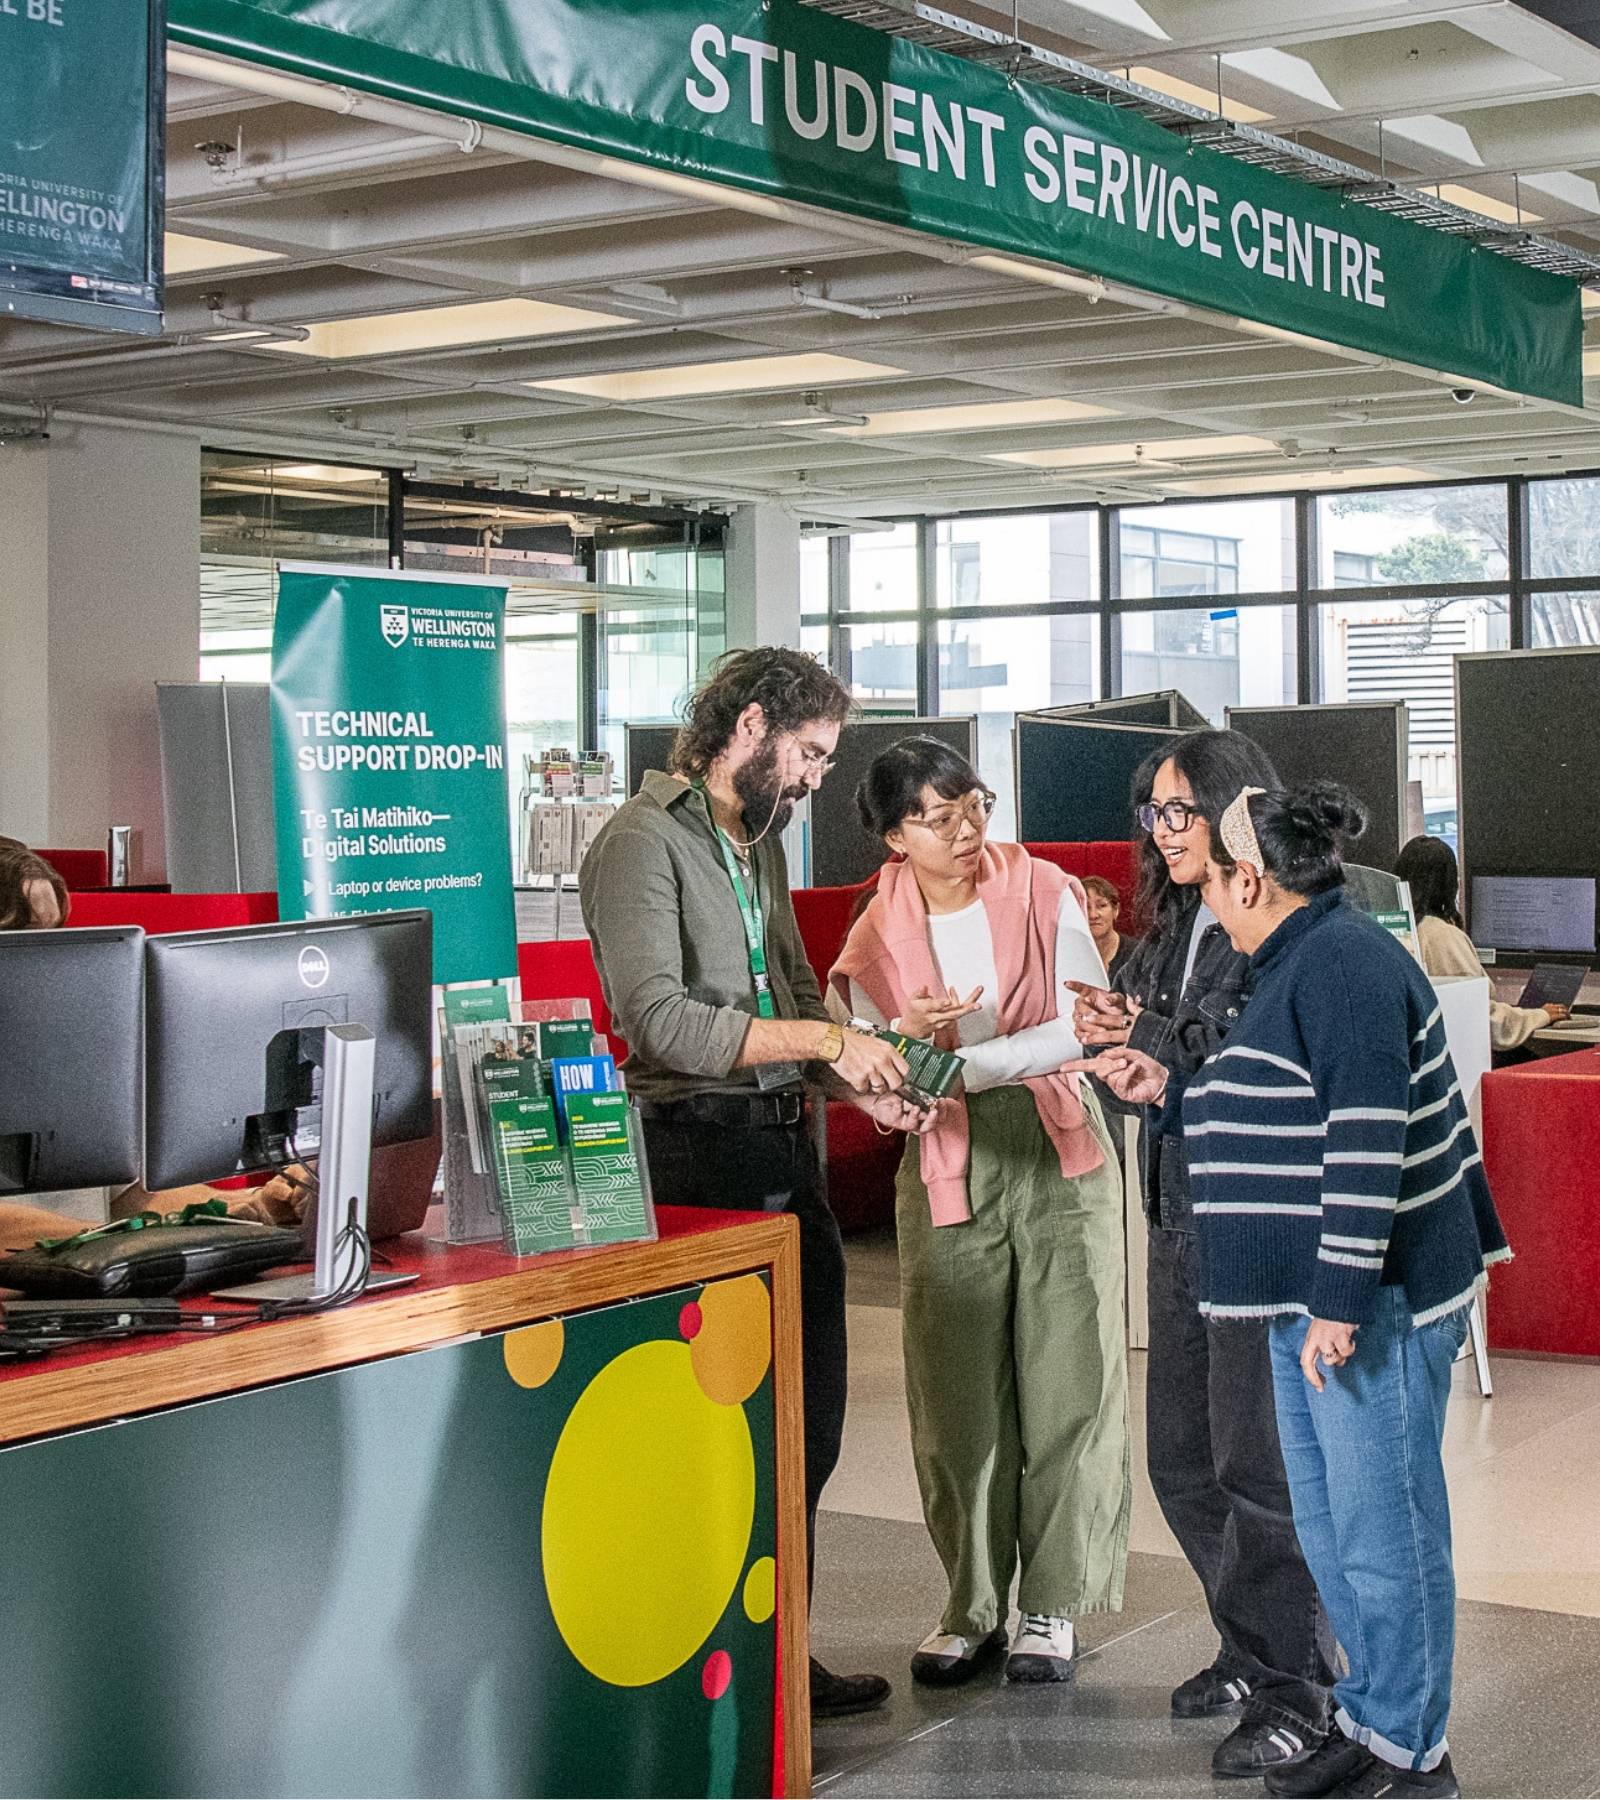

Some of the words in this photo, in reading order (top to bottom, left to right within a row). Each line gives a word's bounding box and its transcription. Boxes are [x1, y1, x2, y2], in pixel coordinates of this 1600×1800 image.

[27, 0, 64, 27] BE
[686, 23, 1005, 188] STUDENT
[1023, 126, 1222, 258] SERVICE
[1231, 201, 1386, 308] CENTRE
[31, 179, 104, 200] UNIVERSITY
[108, 194, 125, 206] OF
[76, 231, 123, 252] WAKA
[411, 608, 442, 617] VICTORIA
[444, 609, 484, 619] UNIVERSITY
[484, 612, 494, 620] OF
[411, 617, 496, 638] WELLINGTON
[412, 636, 425, 647] TE
[427, 637, 471, 649] HERENGA
[473, 639, 497, 650] WAKA
[295, 711, 434, 738] TECHNICAL
[298, 743, 409, 772] SUPPORT
[414, 744, 504, 771] DROP-IN
[300, 809, 327, 830] Te
[331, 806, 359, 829] Tai
[302, 835, 365, 862] Digital
[368, 833, 446, 856] Solutions
[328, 880, 370, 898] Laptop
[372, 881, 383, 892] or
[385, 875, 422, 892] device
[424, 871, 483, 894] problems?
[302, 961, 326, 973] DELL
[560, 1063, 594, 1091] HOW
[488, 1089, 519, 1100] STUDENT
